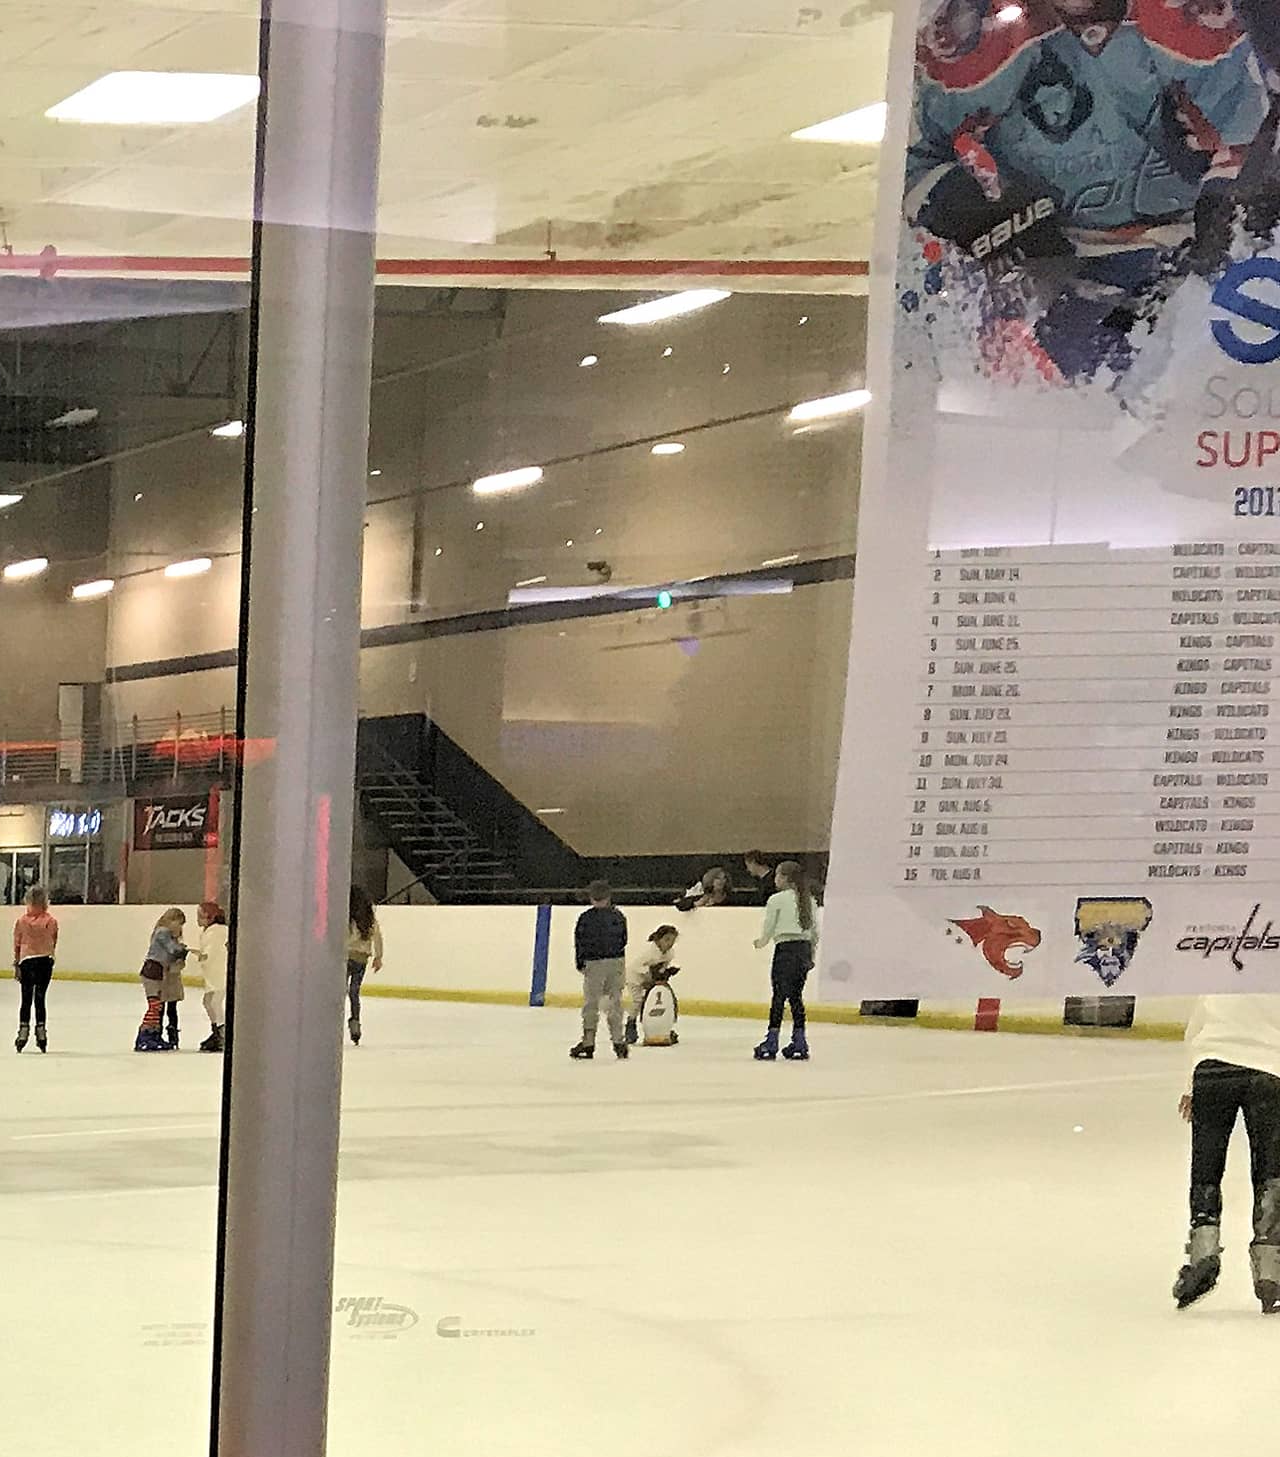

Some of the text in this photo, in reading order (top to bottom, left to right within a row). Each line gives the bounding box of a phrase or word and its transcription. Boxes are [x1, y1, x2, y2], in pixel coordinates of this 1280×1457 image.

[1234, 486, 1280, 516] 201
[934, 569, 941, 581] 2
[933, 592, 940, 604] 3
[932, 616, 939, 627] 4
[1171, 612, 1219, 624] CAPITALS
[930, 639, 937, 651] 5
[1180, 636, 1212, 648] KINGS
[928, 662, 936, 674] 6
[927, 685, 934, 697] 7
[924, 708, 931, 720] 8
[921, 731, 929, 744] 9
[919, 755, 932, 767] 10
[916, 778, 927, 790] 11
[1153, 774, 1203, 786] CAPITALS
[913, 801, 926, 813] 12
[143, 802, 207, 835] TACKS
[910, 823, 923, 836] 13
[908, 846, 921, 858] 14
[1153, 842, 1203, 854] CAPITALS
[904, 869, 918, 881] 15
[1148, 865, 1201, 877] WILDCATS
